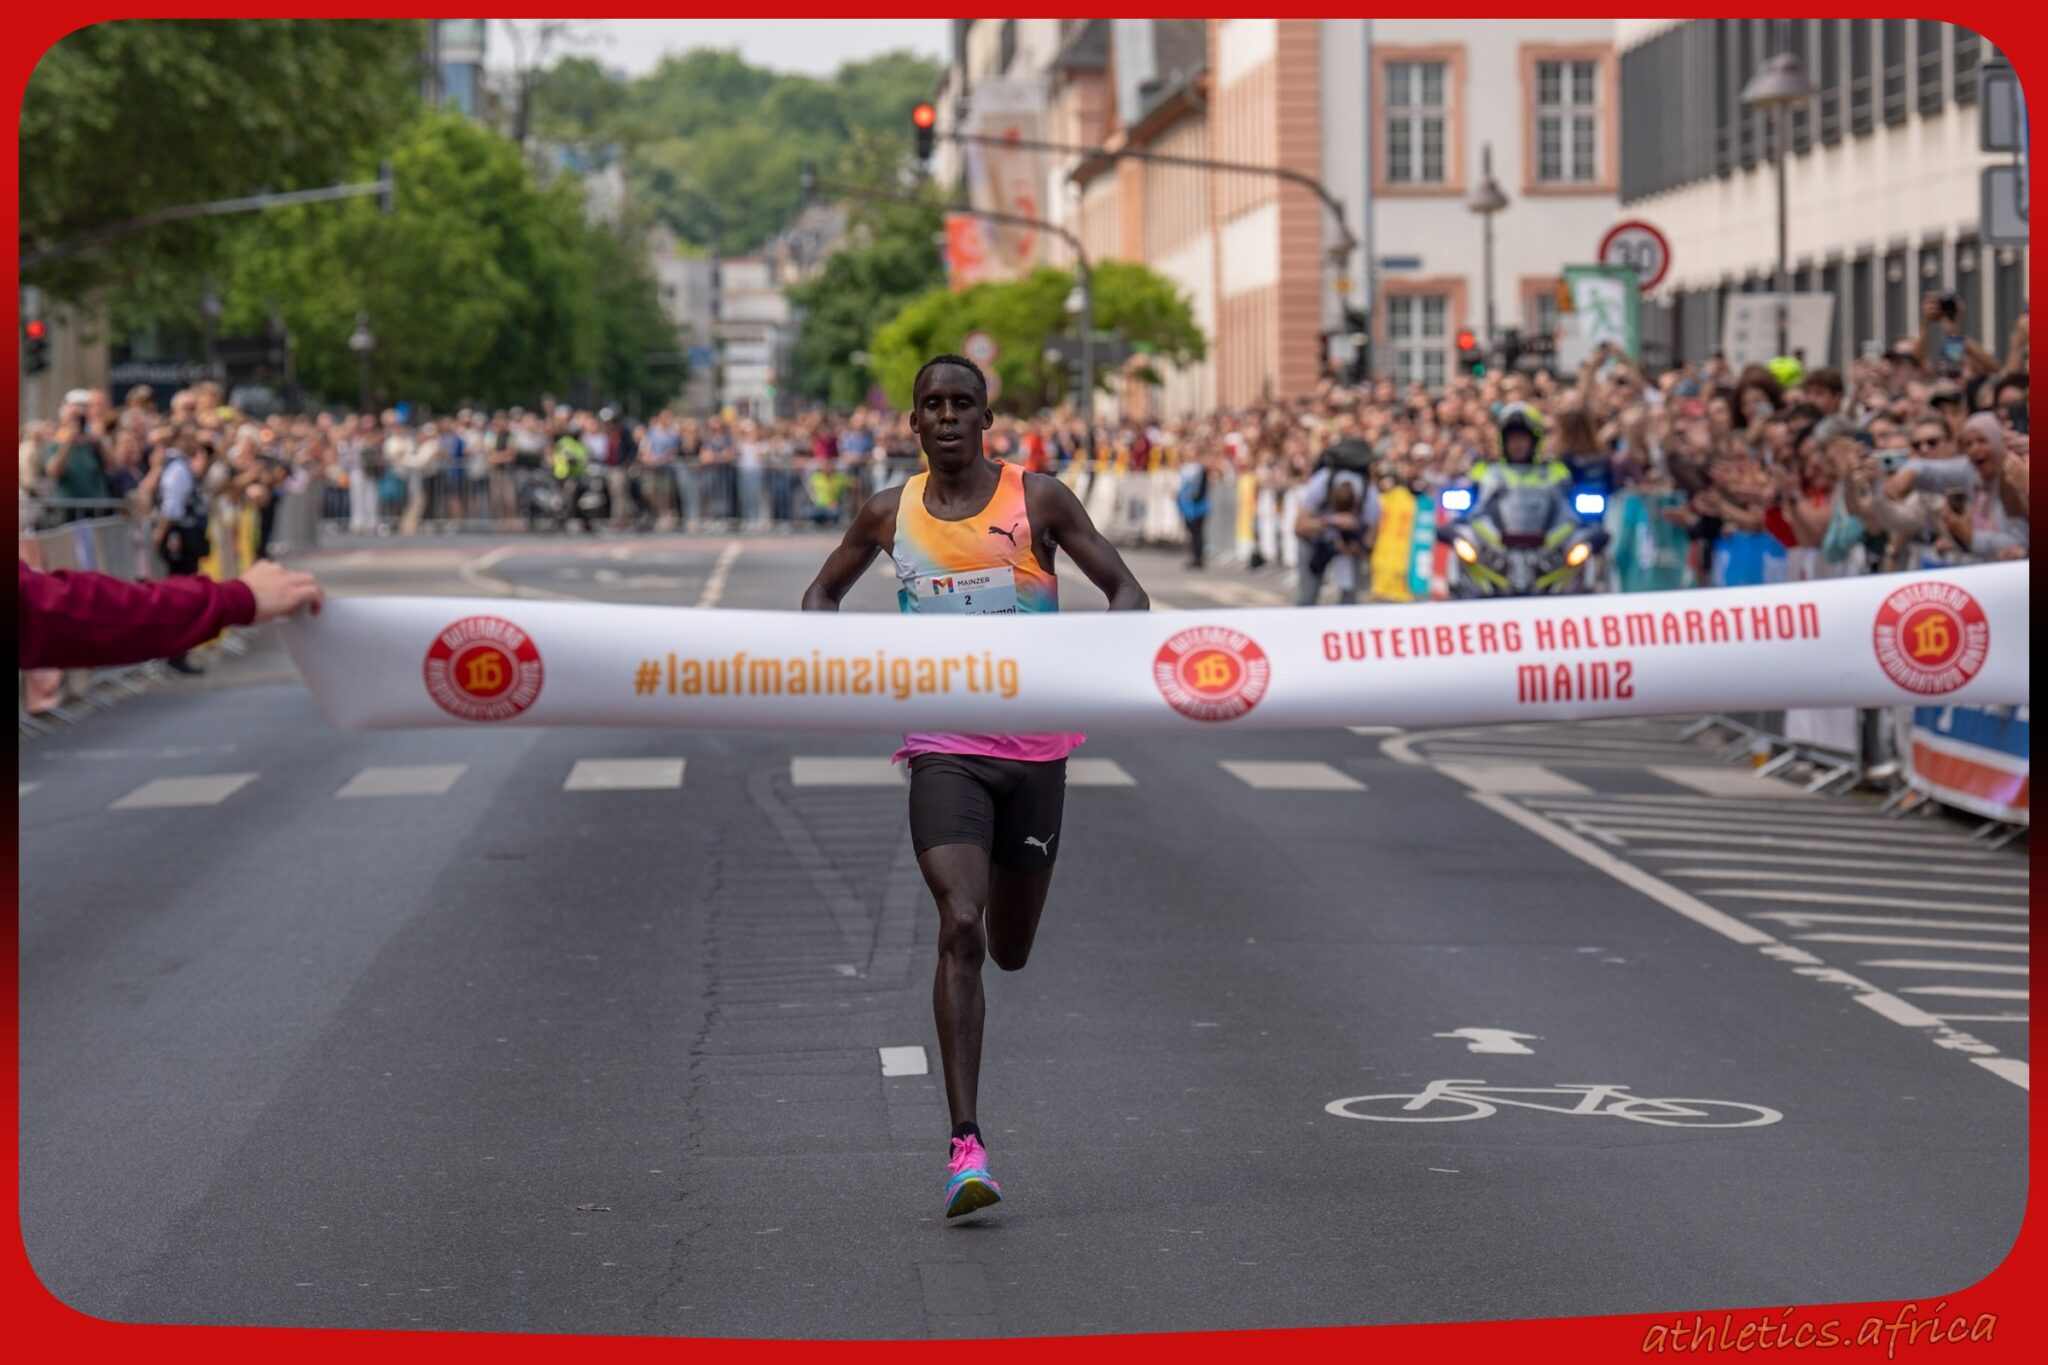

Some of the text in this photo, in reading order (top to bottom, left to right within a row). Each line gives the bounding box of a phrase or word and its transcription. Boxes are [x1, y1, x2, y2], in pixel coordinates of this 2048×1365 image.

[957, 576, 991, 587] MAINZER
[964, 595, 972, 605] 2
[1322, 603, 1820, 661] GUTENBERG HALBMARATHON
[633, 650, 1019, 701] #laufmainzigartig
[1517, 660, 1635, 704] MAINZ
